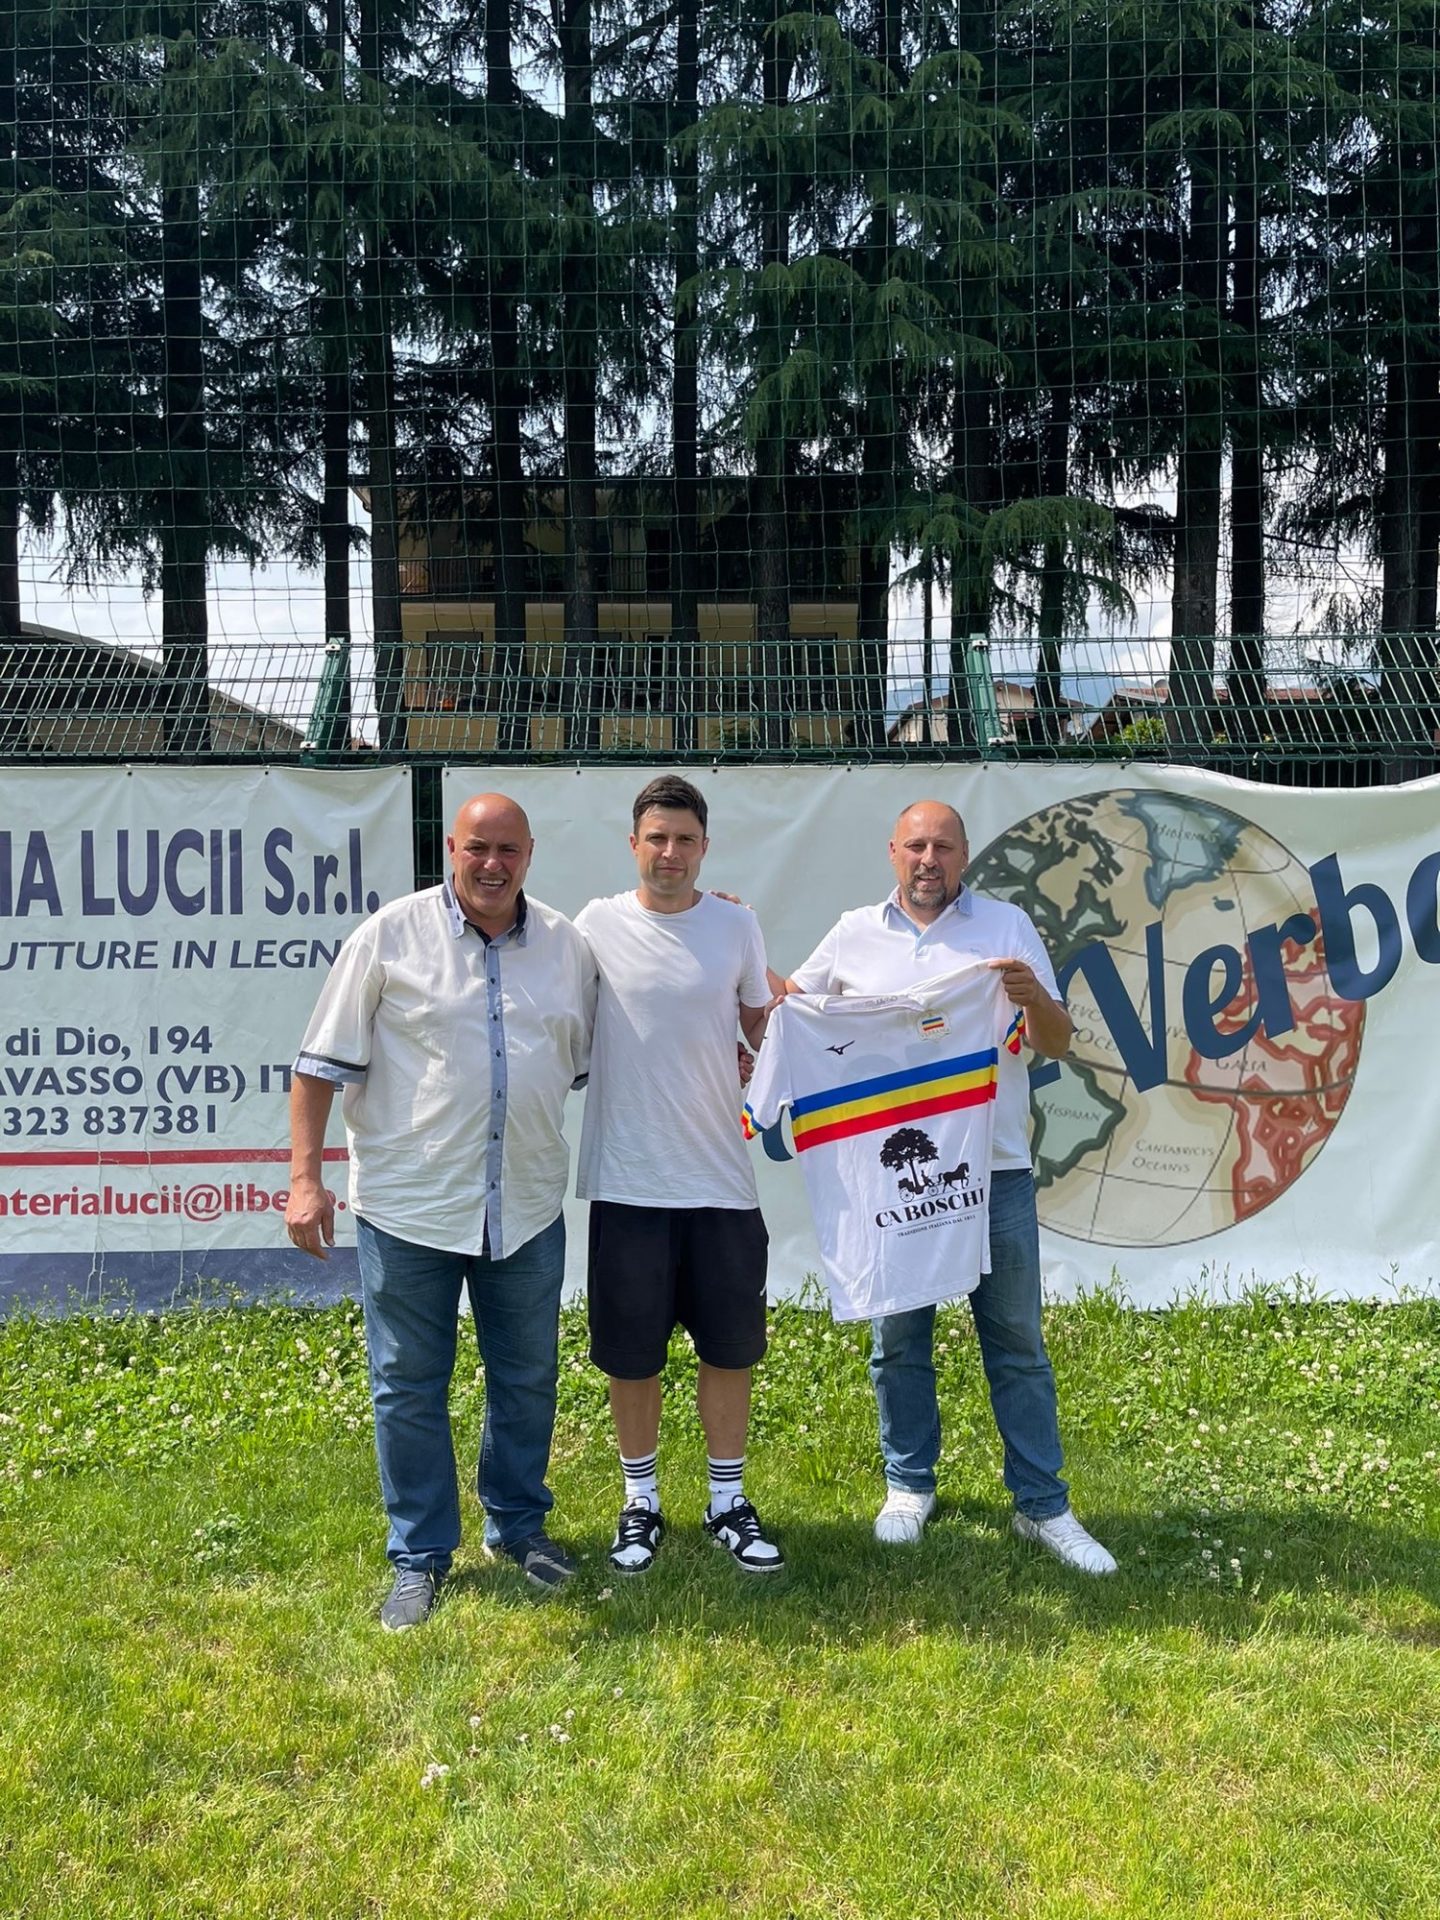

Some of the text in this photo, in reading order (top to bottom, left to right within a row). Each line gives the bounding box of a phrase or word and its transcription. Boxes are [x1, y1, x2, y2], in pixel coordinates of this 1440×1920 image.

[81, 828, 243, 917] LUCII
[264, 827, 380, 916] S.r.l.
[172, 940, 217, 969] IN
[6, 1025, 213, 1061] di Dio, 194
[0, 1066, 144, 1096] VASSO
[157, 1065, 246, 1103] (VB)
[3, 1104, 216, 1137] 323 837381
[0, 1184, 347, 1222] terialucii@libe.
[904, 1187, 984, 1222] BOSCHI
